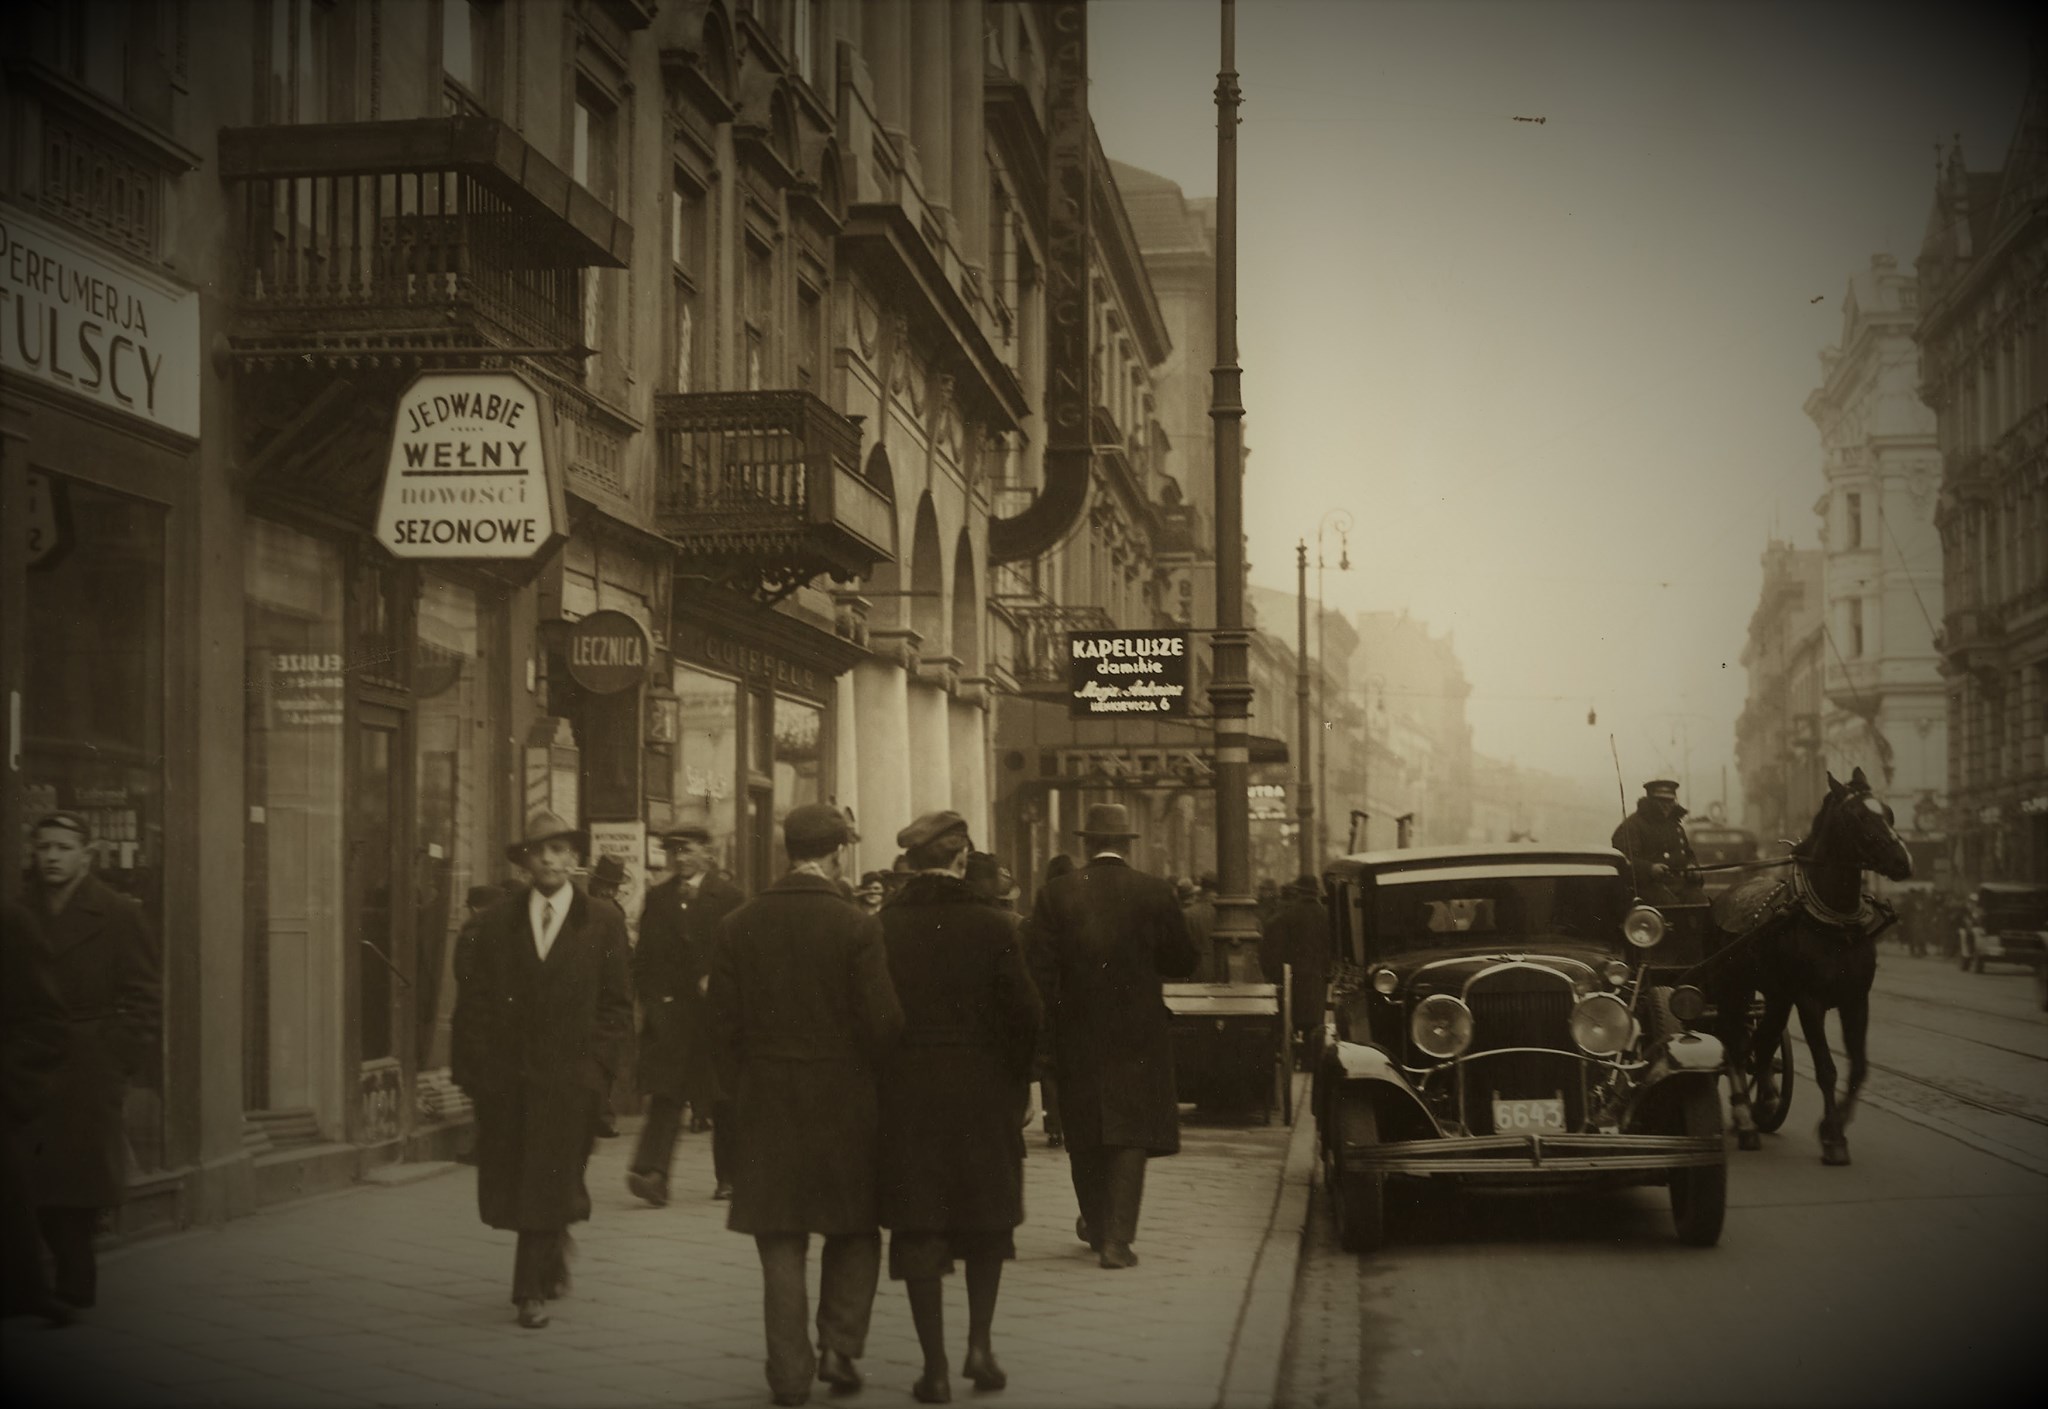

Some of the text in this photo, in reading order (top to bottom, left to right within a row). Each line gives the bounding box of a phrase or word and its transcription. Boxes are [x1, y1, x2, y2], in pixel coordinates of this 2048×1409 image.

[0, 285, 163, 411] ULSCY
[407, 392, 525, 434] JEDWABIE
[403, 440, 527, 468] WEŁNY
[394, 519, 536, 544] SEZONOWE
[573, 635, 643, 666] LECZNICA
[1072, 638, 1184, 658] KAPELUSZE
[1096, 656, 1163, 674] damskie
[1159, 697, 1171, 711] 6
[1496, 1102, 1562, 1129] 6643
